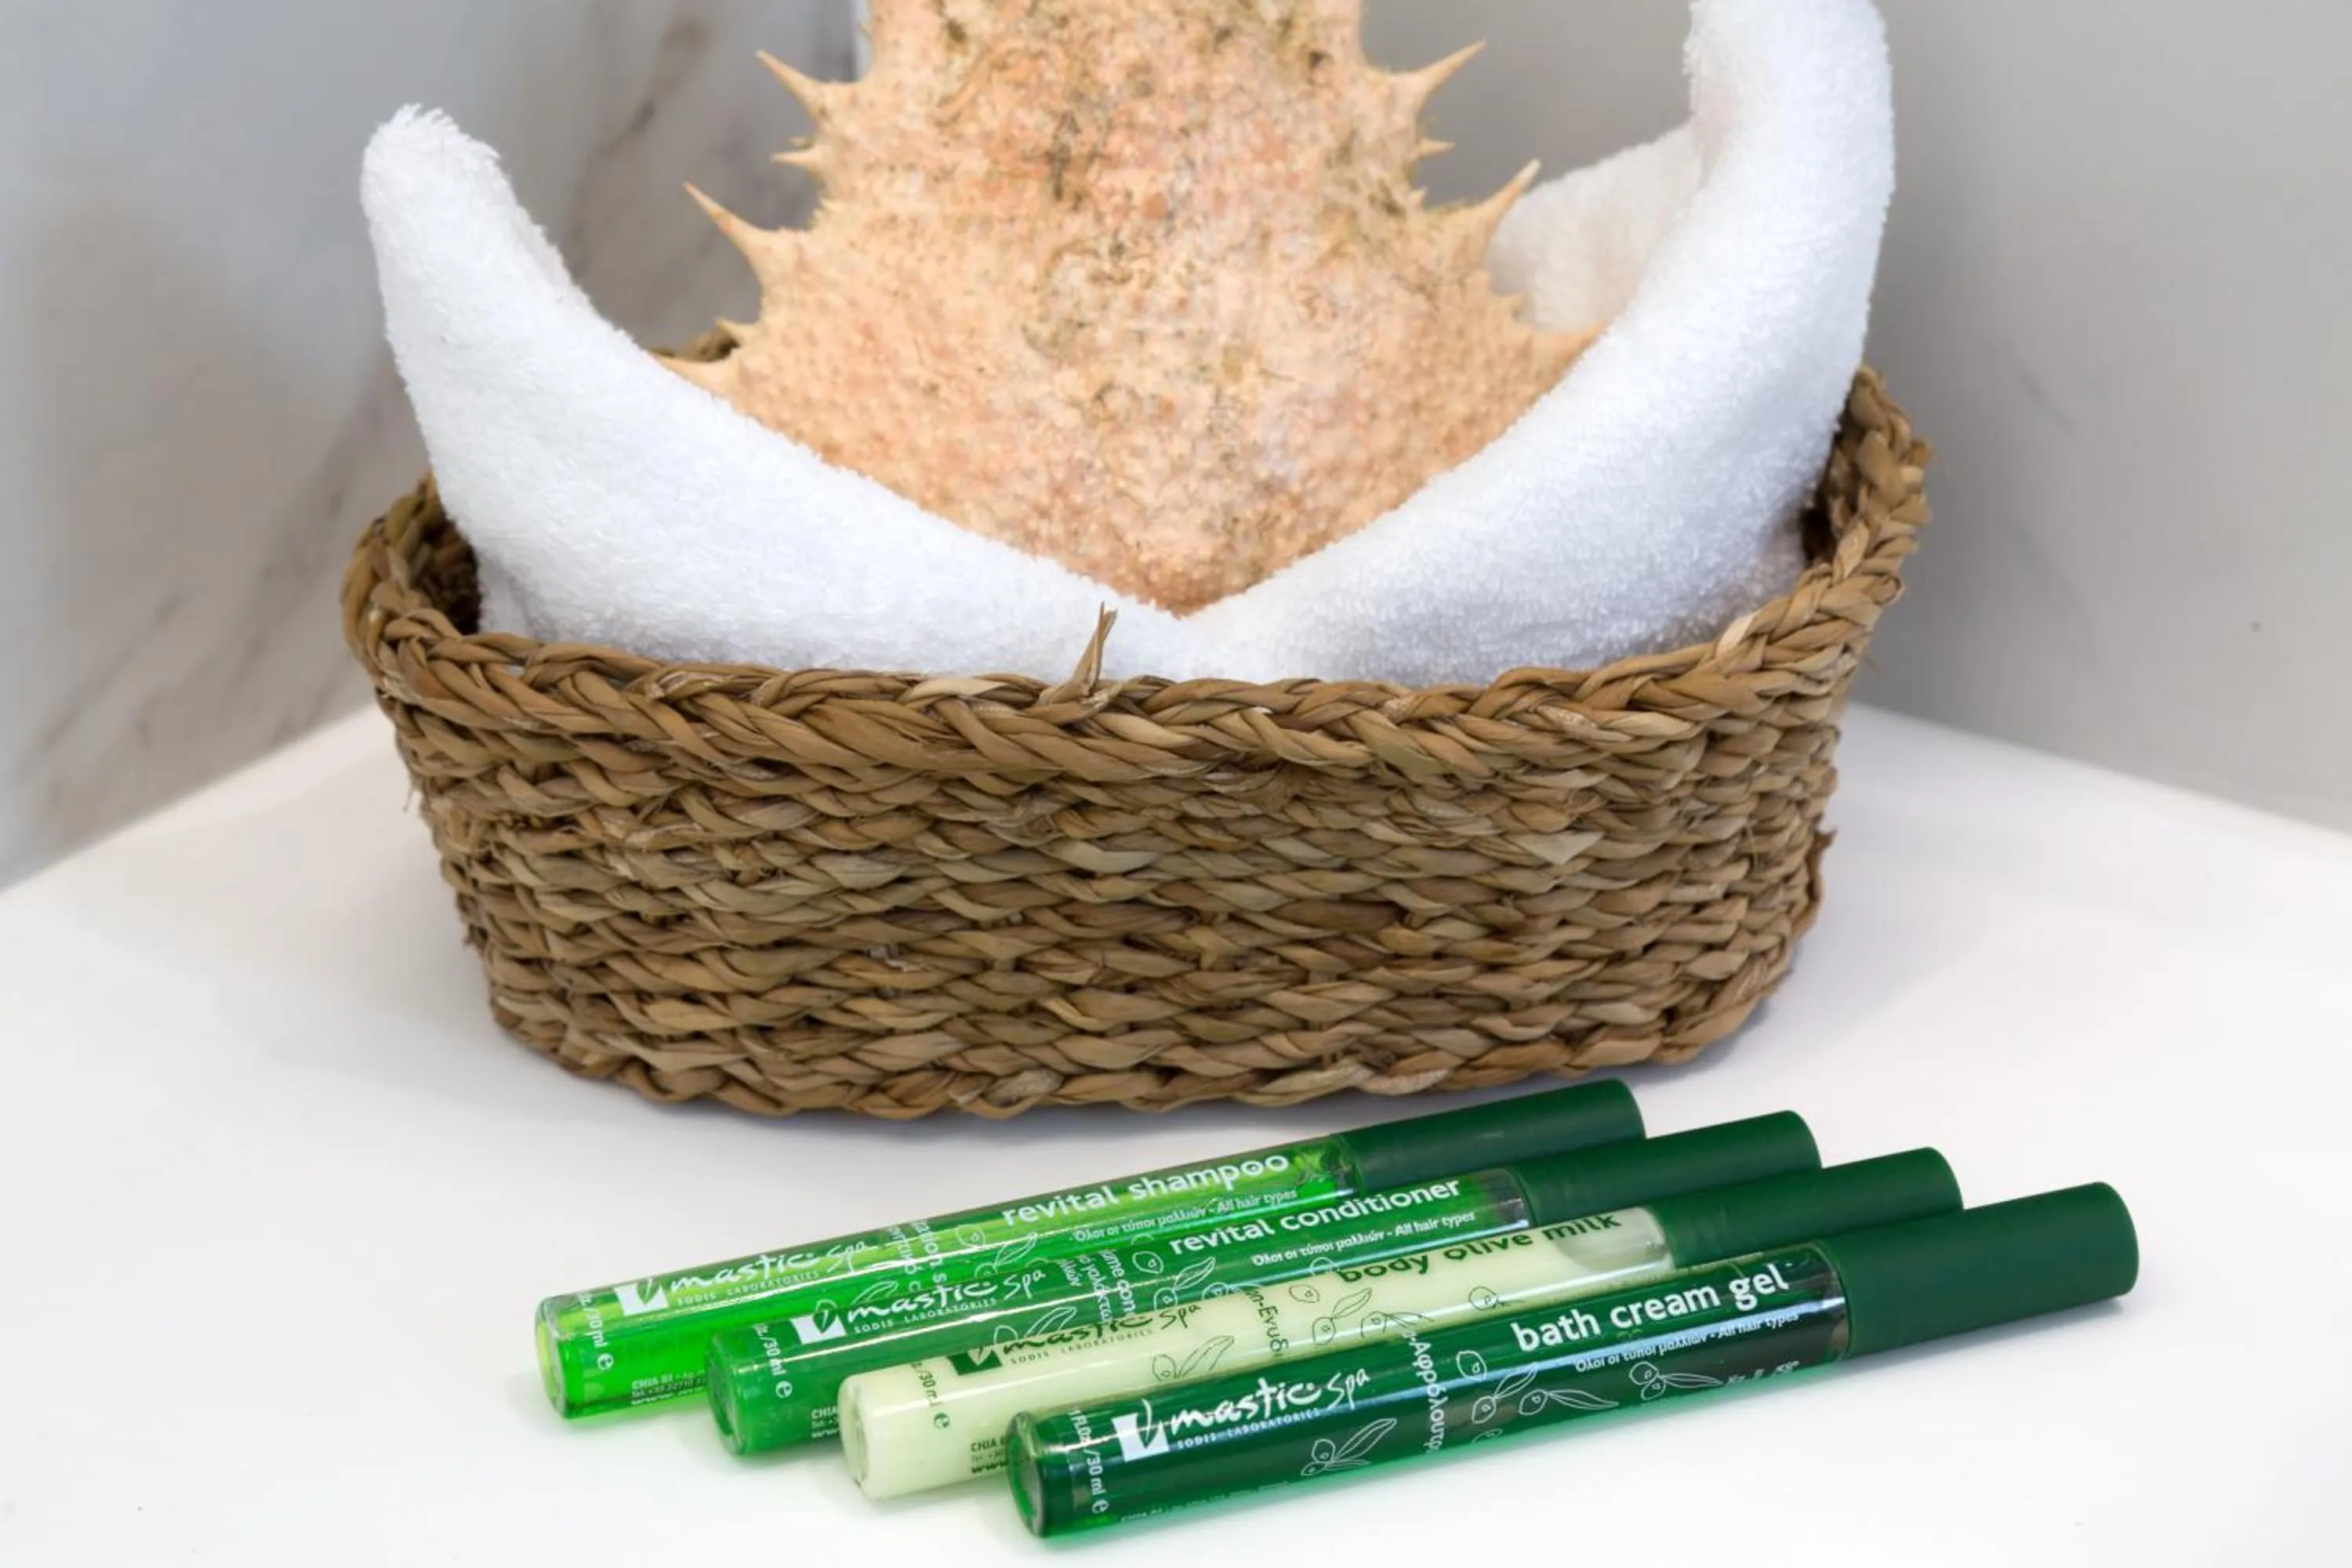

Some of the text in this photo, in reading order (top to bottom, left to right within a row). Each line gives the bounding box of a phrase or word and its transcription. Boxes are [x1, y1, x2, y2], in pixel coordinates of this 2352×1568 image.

[1001, 1154, 1290, 1227] revital shampoo
[1217, 1199, 1234, 1214] All
[1235, 1196, 1261, 1210] hair
[1263, 1189, 1298, 1206] types
[1169, 1178, 1462, 1255] revital conditioner
[1395, 1222, 1414, 1236] All
[1414, 1218, 1439, 1232] hair
[1441, 1211, 1475, 1229] types
[1336, 1211, 1624, 1283] body olive milk
[670, 1253, 821, 1295] mastic
[727, 1269, 821, 1297] LABORATORIES
[847, 1281, 998, 1323] mastic
[855, 1298, 997, 1334] SODIS LABORATORIES
[1510, 1262, 1790, 1352] bath cream gel
[1003, 1317, 1155, 1355] mastic
[1719, 1323, 1737, 1338] All
[1737, 1319, 1762, 1334] hair
[1764, 1313, 1799, 1330] types
[1009, 1328, 1155, 1365] SODIS LABORATORIES
[1171, 1377, 1323, 1436] mastic
[1176, 1407, 1321, 1450] SODIS LABORATORIES
[1090, 1477, 1107, 1496] ml
